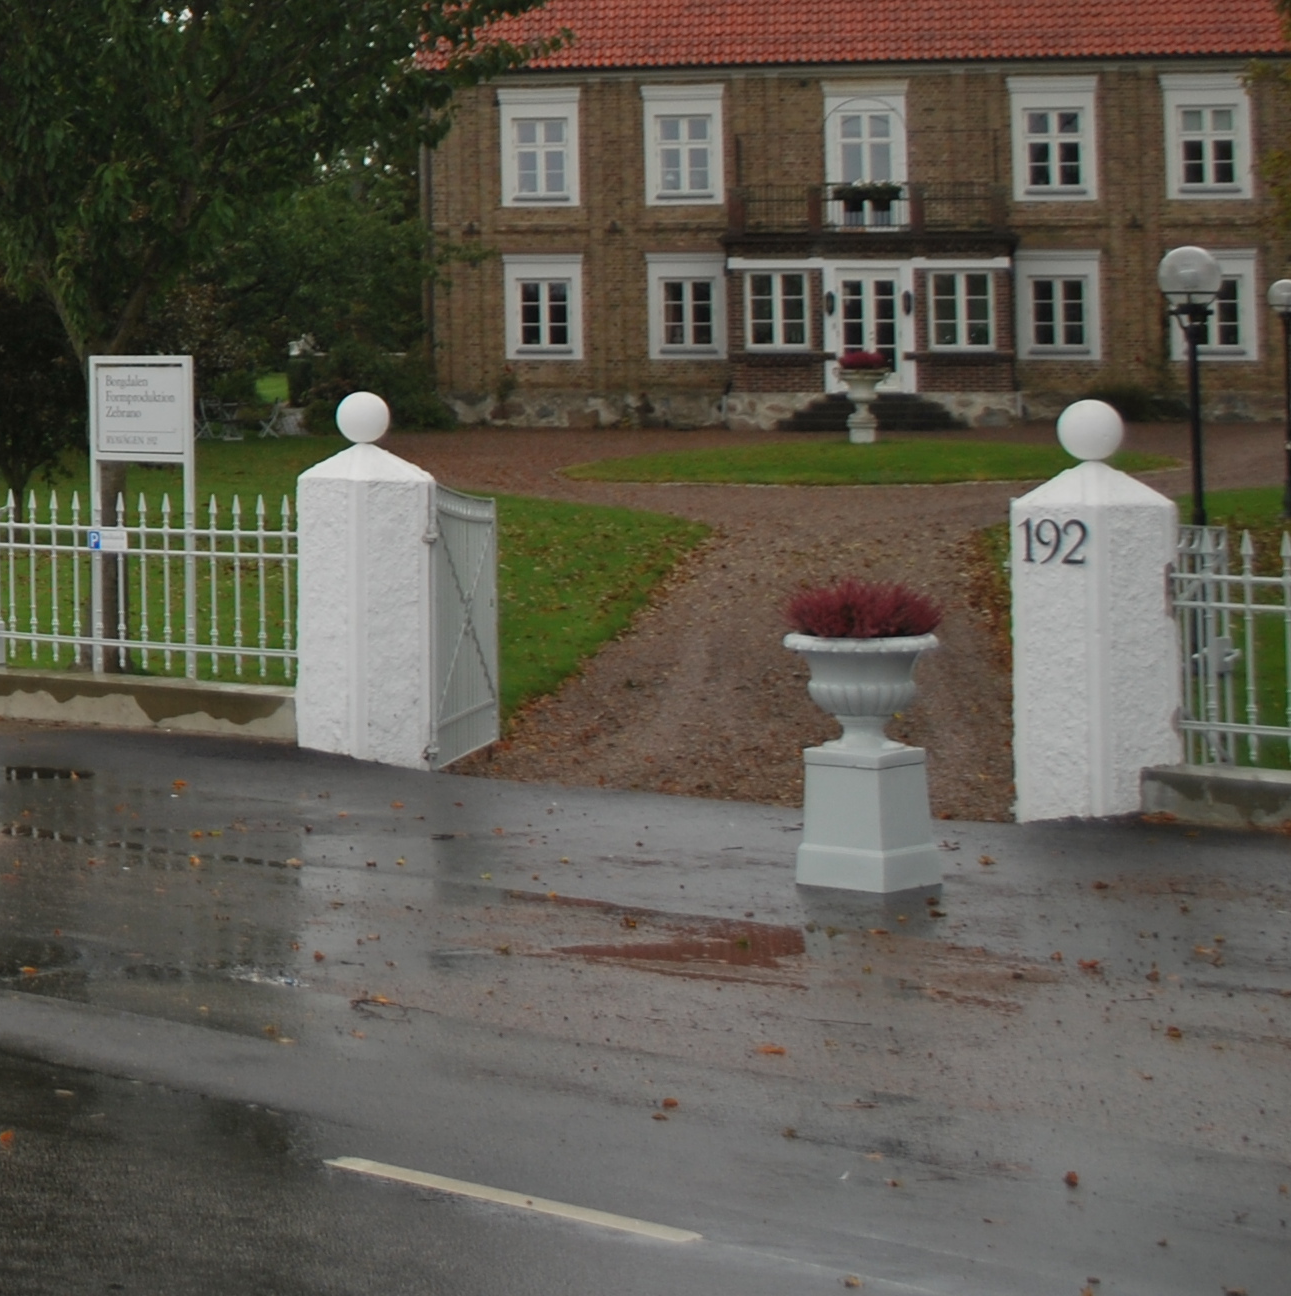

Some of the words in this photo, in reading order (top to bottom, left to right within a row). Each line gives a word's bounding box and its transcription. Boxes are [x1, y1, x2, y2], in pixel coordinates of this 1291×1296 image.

[105, 374, 148, 389] Borgdalen
[105, 390, 176, 405] Formproduktion
[105, 405, 142, 418] Zebrano
[90, 532, 99, 548] P
[1017, 517, 1088, 566] 192
